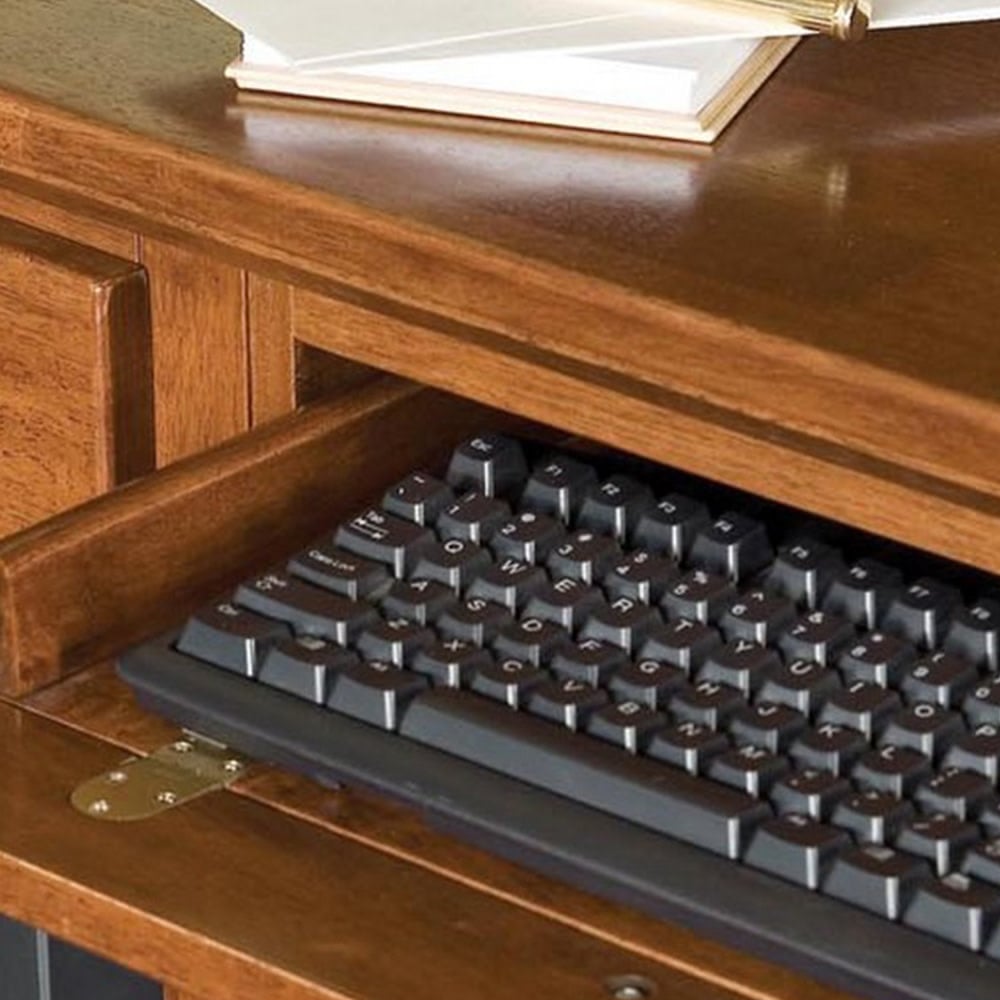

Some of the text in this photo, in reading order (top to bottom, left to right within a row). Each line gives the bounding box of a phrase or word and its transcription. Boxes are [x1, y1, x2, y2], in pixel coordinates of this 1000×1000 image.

[545, 464, 562, 476] F1
[601, 482, 621, 496] F2
[657, 501, 676, 514] F3
[366, 511, 386, 525] Tab
[502, 525, 517, 536] 2
[713, 519, 733, 532] F4
[444, 540, 464, 554] Q
[557, 544, 574, 556] 3
[501, 559, 528, 575] W
[410, 580, 429, 592] A
[554, 579, 577, 593] E
[909, 585, 930, 599] F7
[466, 599, 486, 612] S
[611, 598, 635, 613] R
[675, 618, 694, 633] T
[735, 640, 755, 655] Y
[502, 660, 522, 672] C
[640, 659, 661, 674] G
[789, 660, 814, 676] U
[563, 680, 586, 692] V
[697, 681, 721, 696] H
[617, 701, 641, 715] B
[757, 706, 778, 717] J
[914, 704, 935, 719] O
[679, 722, 702, 737] N
[818, 725, 843, 740] K
[975, 724, 997, 738] P
[739, 746, 766, 760] M
[880, 746, 897, 761] L
